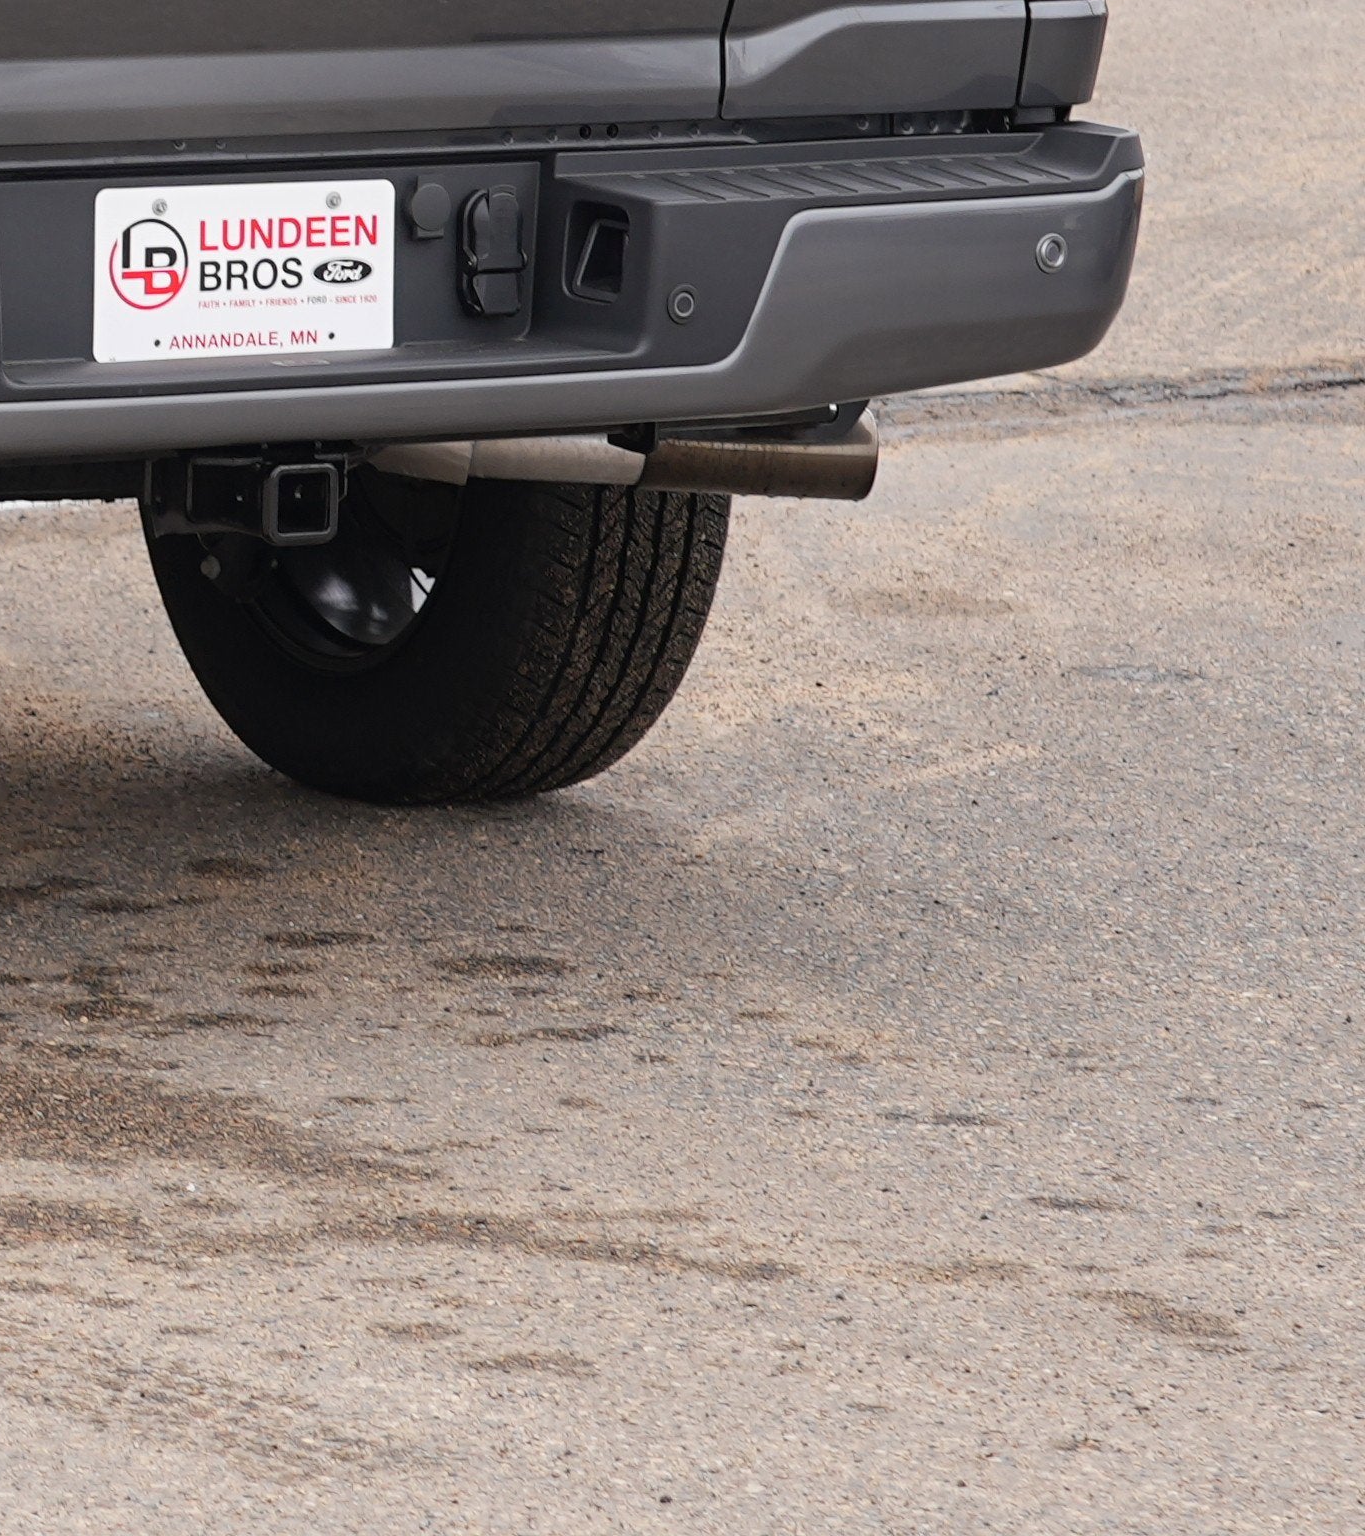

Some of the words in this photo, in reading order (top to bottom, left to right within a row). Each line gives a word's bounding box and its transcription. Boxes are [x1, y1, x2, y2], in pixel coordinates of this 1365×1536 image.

[199, 215, 377, 251] LUNDEEN
[199, 257, 303, 291] BROS
[307, 296, 327, 304] FORD
[169, 330, 283, 350] ANNANDALE,
[290, 329, 318, 346] MN
